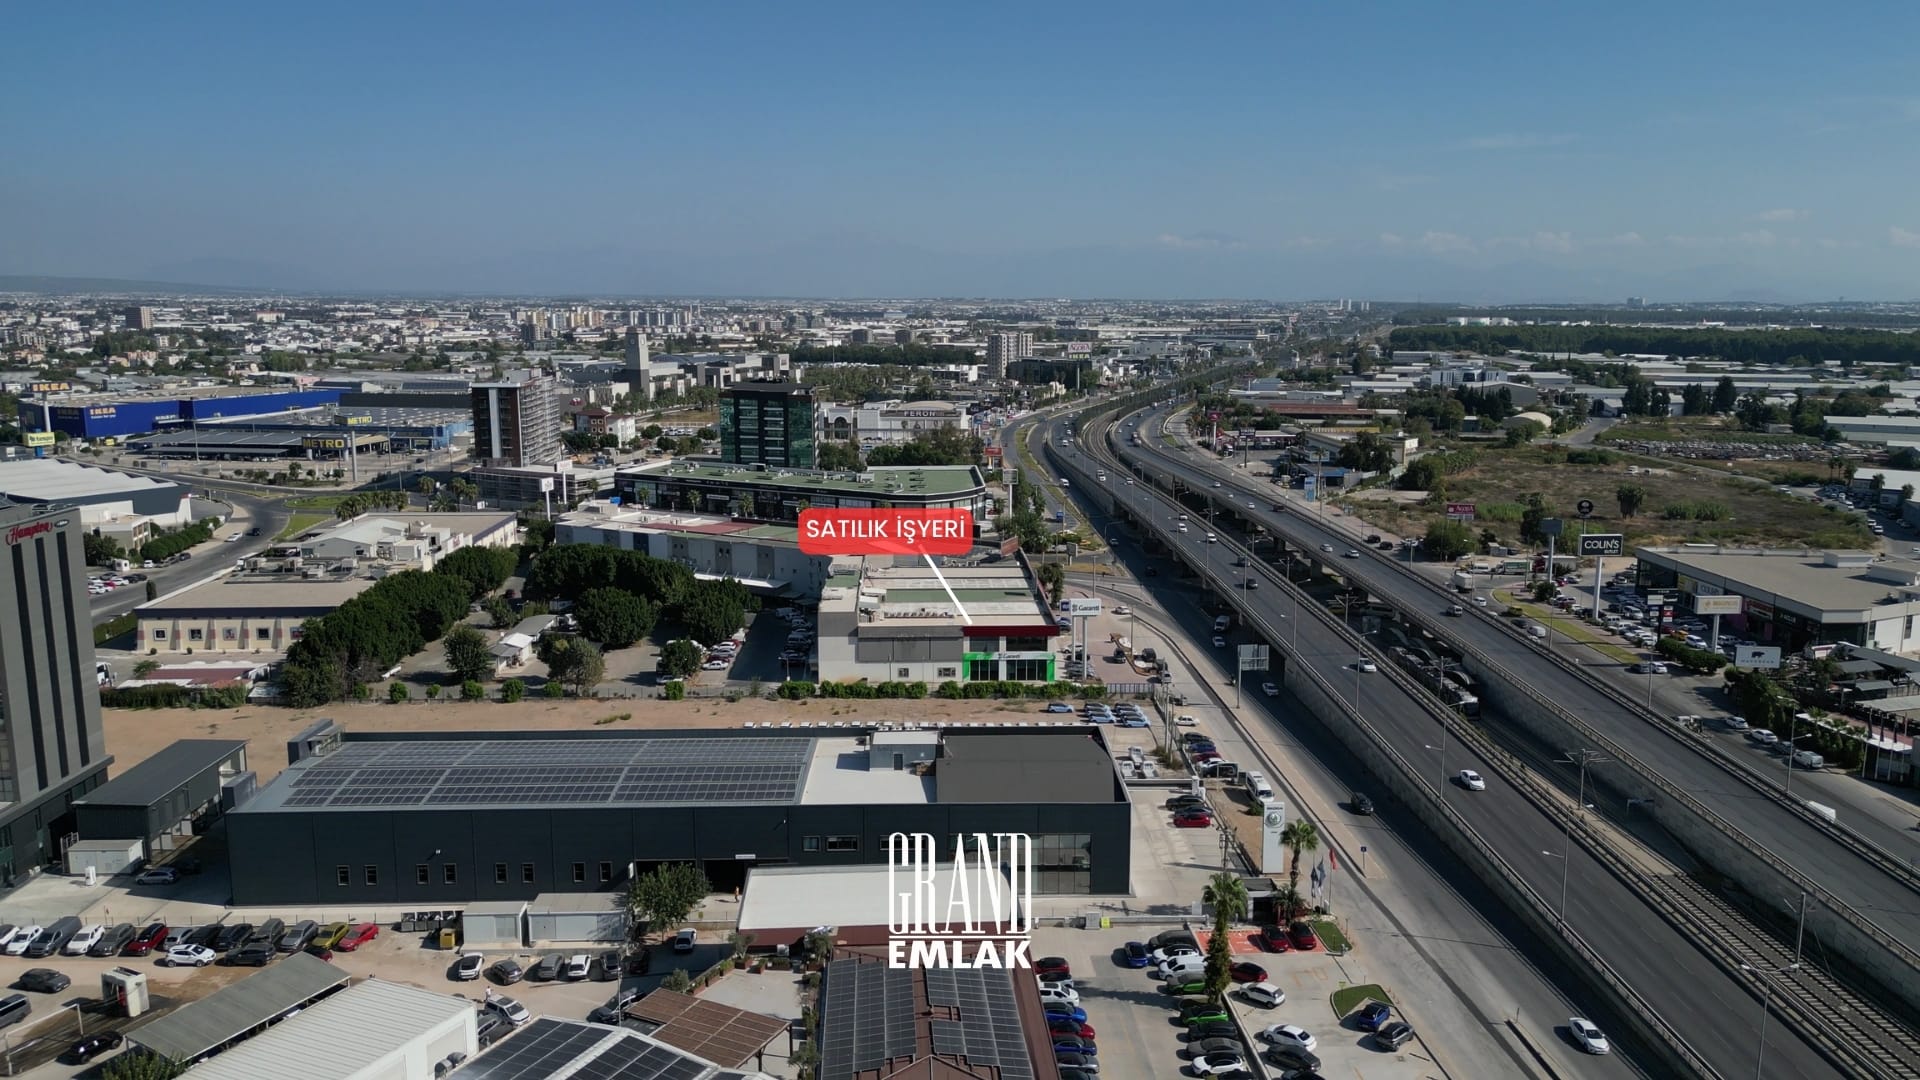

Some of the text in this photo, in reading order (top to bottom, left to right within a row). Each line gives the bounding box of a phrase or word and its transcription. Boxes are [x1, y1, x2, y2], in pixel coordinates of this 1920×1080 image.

[32, 383, 70, 391] IKEA
[89, 407, 116, 415] IKEA
[347, 415, 373, 425] METRO
[303, 439, 345, 448] METRO
[5, 521, 53, 546] Hampton
[1584, 539, 1620, 549] COLIN'S
